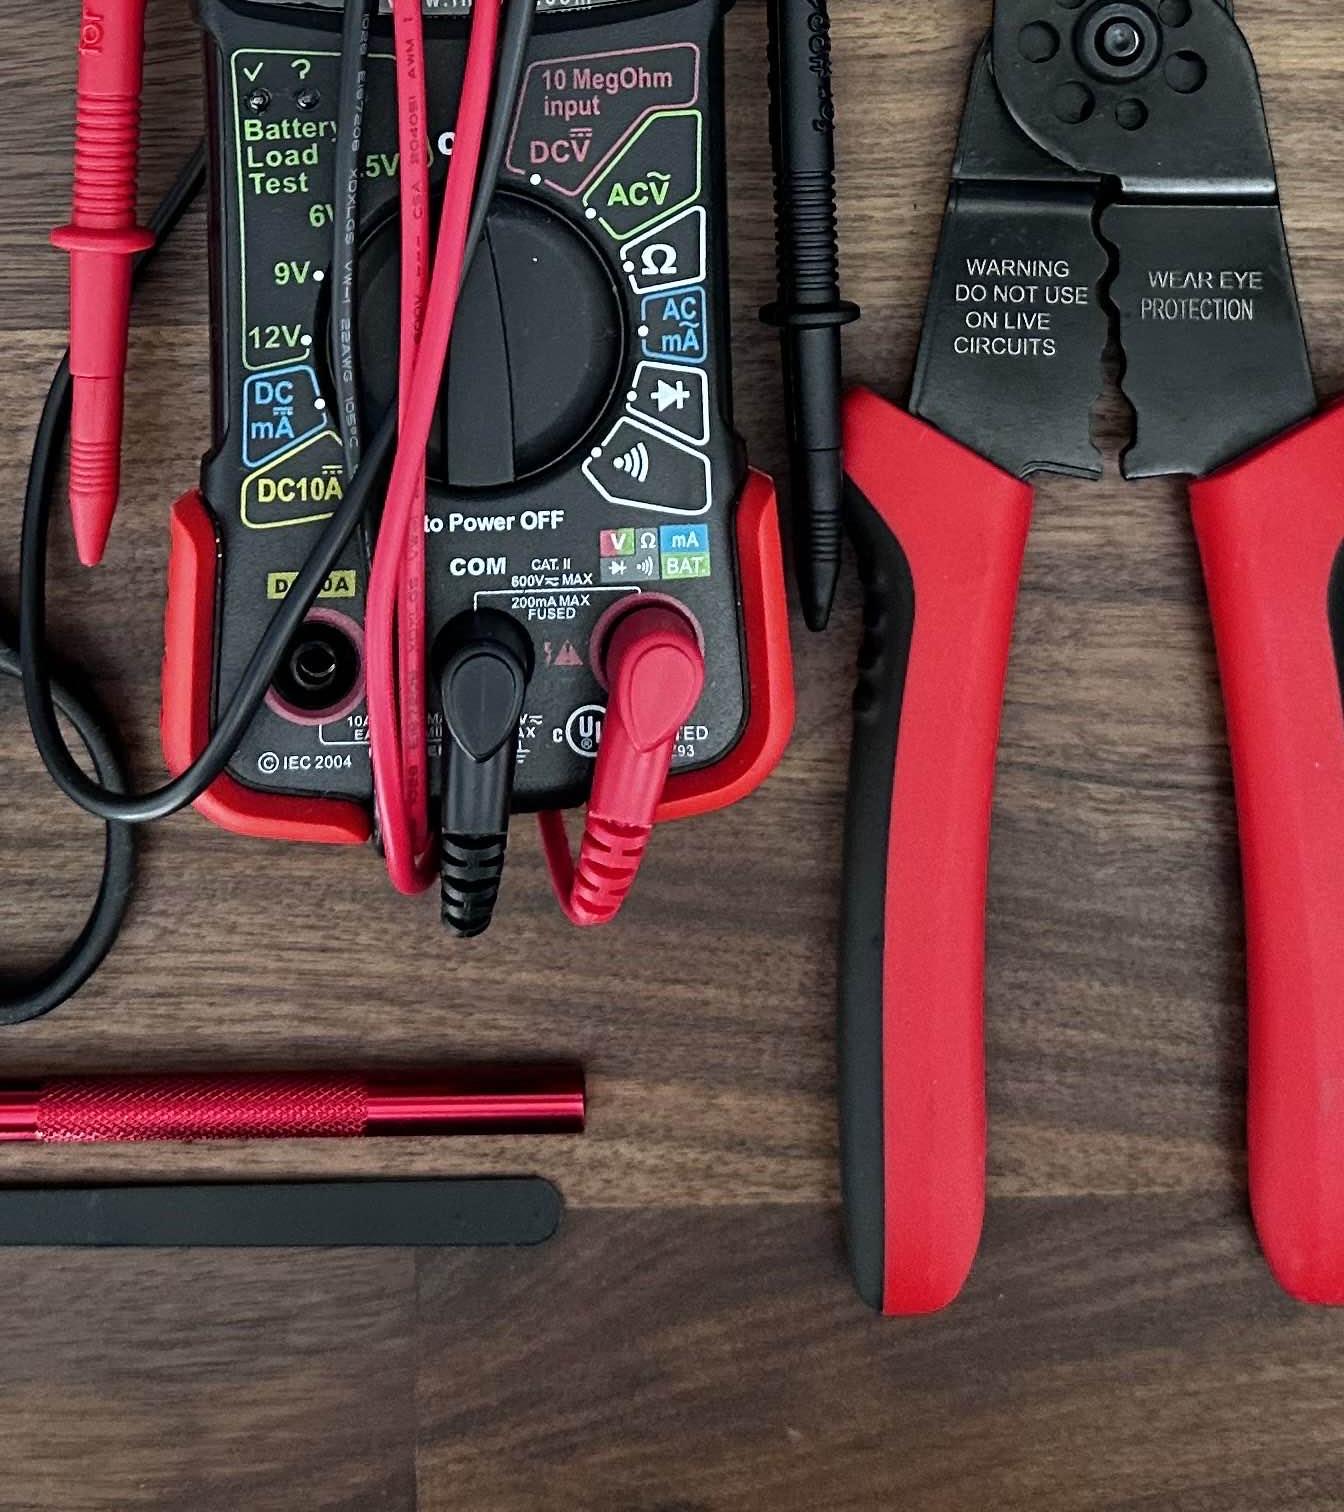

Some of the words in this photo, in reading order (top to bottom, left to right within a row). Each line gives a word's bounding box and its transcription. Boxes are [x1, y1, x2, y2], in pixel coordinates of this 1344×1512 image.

[542, 69, 566, 90] 10
[573, 67, 673, 95] MegOhm
[544, 95, 601, 121] input
[247, 143, 318, 169] Load
[529, 139, 592, 164] DCV
[248, 172, 309, 194] Test
[607, 181, 670, 206] ACV
[274, 261, 310, 286] 9V
[966, 259, 1070, 278] WARNING
[1148, 271, 1213, 289] WEAR
[1220, 271, 1264, 290] EYE
[955, 284, 987, 304] DO
[993, 285, 1039, 304] NOT
[1045, 286, 1089, 305] USE
[663, 296, 697, 322] AC
[1141, 298, 1255, 321] PROTECTION
[965, 311, 997, 330] ON
[1004, 312, 1051, 331] LIVE
[248, 324, 302, 350] 12V
[662, 328, 700, 352] mA
[953, 336, 1057, 357] CIRCUITS
[339, 318, 354, 383] 22AWG
[255, 380, 294, 406] DC
[251, 415, 295, 440] mA
[258, 477, 344, 503] DC10A
[449, 513, 516, 532] Power
[520, 510, 565, 530] OFF
[610, 533, 627, 551] V
[671, 532, 700, 548] mA
[449, 557, 507, 576] COM
[531, 558, 560, 571] CAT.
[564, 558, 571, 570] II
[667, 559, 706, 575] BAT.
[562, 573, 593, 586] MAX
[511, 595, 557, 609] 200mA
[559, 594, 591, 607] MAX
[528, 607, 577, 621] FUSED
[283, 756, 312, 770] IEC
[315, 754, 353, 770] 2004
